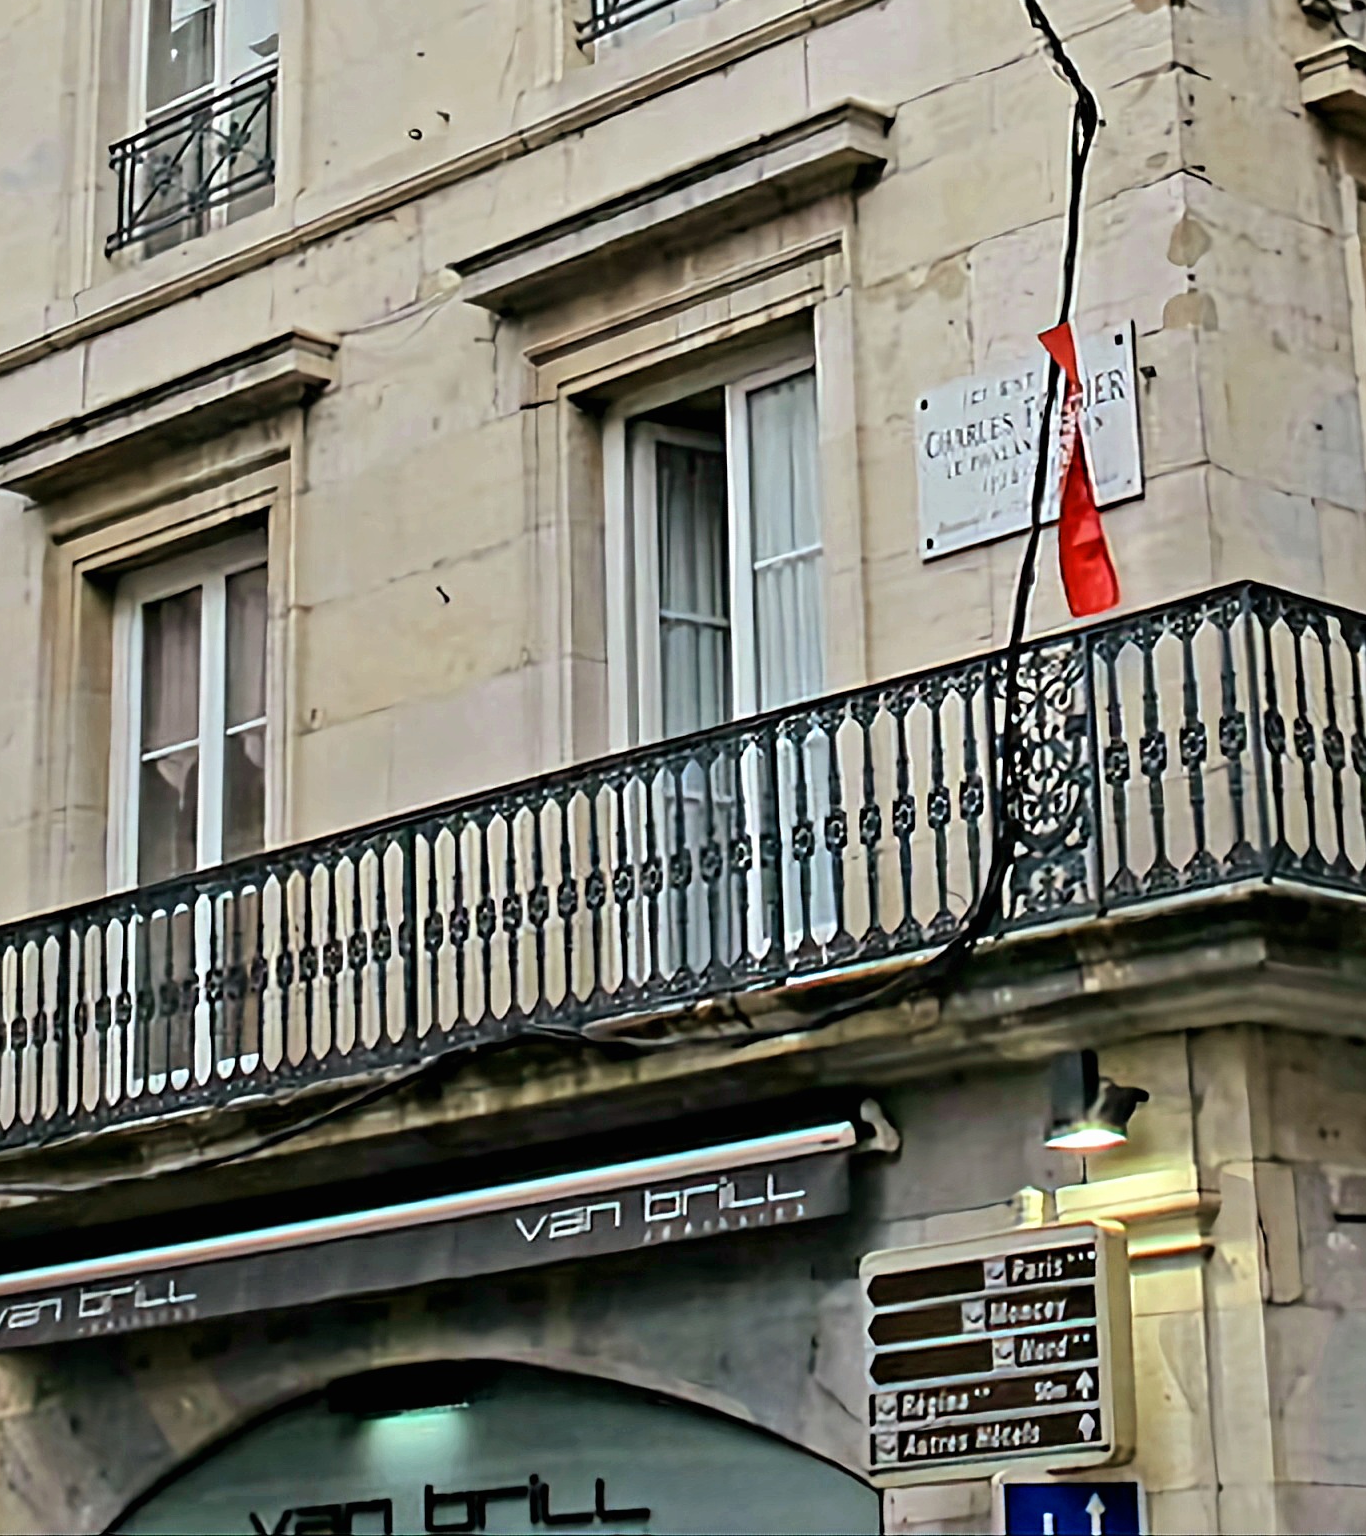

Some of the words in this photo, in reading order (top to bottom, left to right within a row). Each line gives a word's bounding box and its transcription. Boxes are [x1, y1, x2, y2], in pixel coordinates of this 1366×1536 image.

[926, 412, 1014, 459] CHARLES
[516, 1201, 621, 1242] van
[644, 1173, 806, 1223] brill
[1010, 1252, 1063, 1282] Paris
[248, 1497, 394, 1536] van
[424, 1473, 652, 1533] brill
